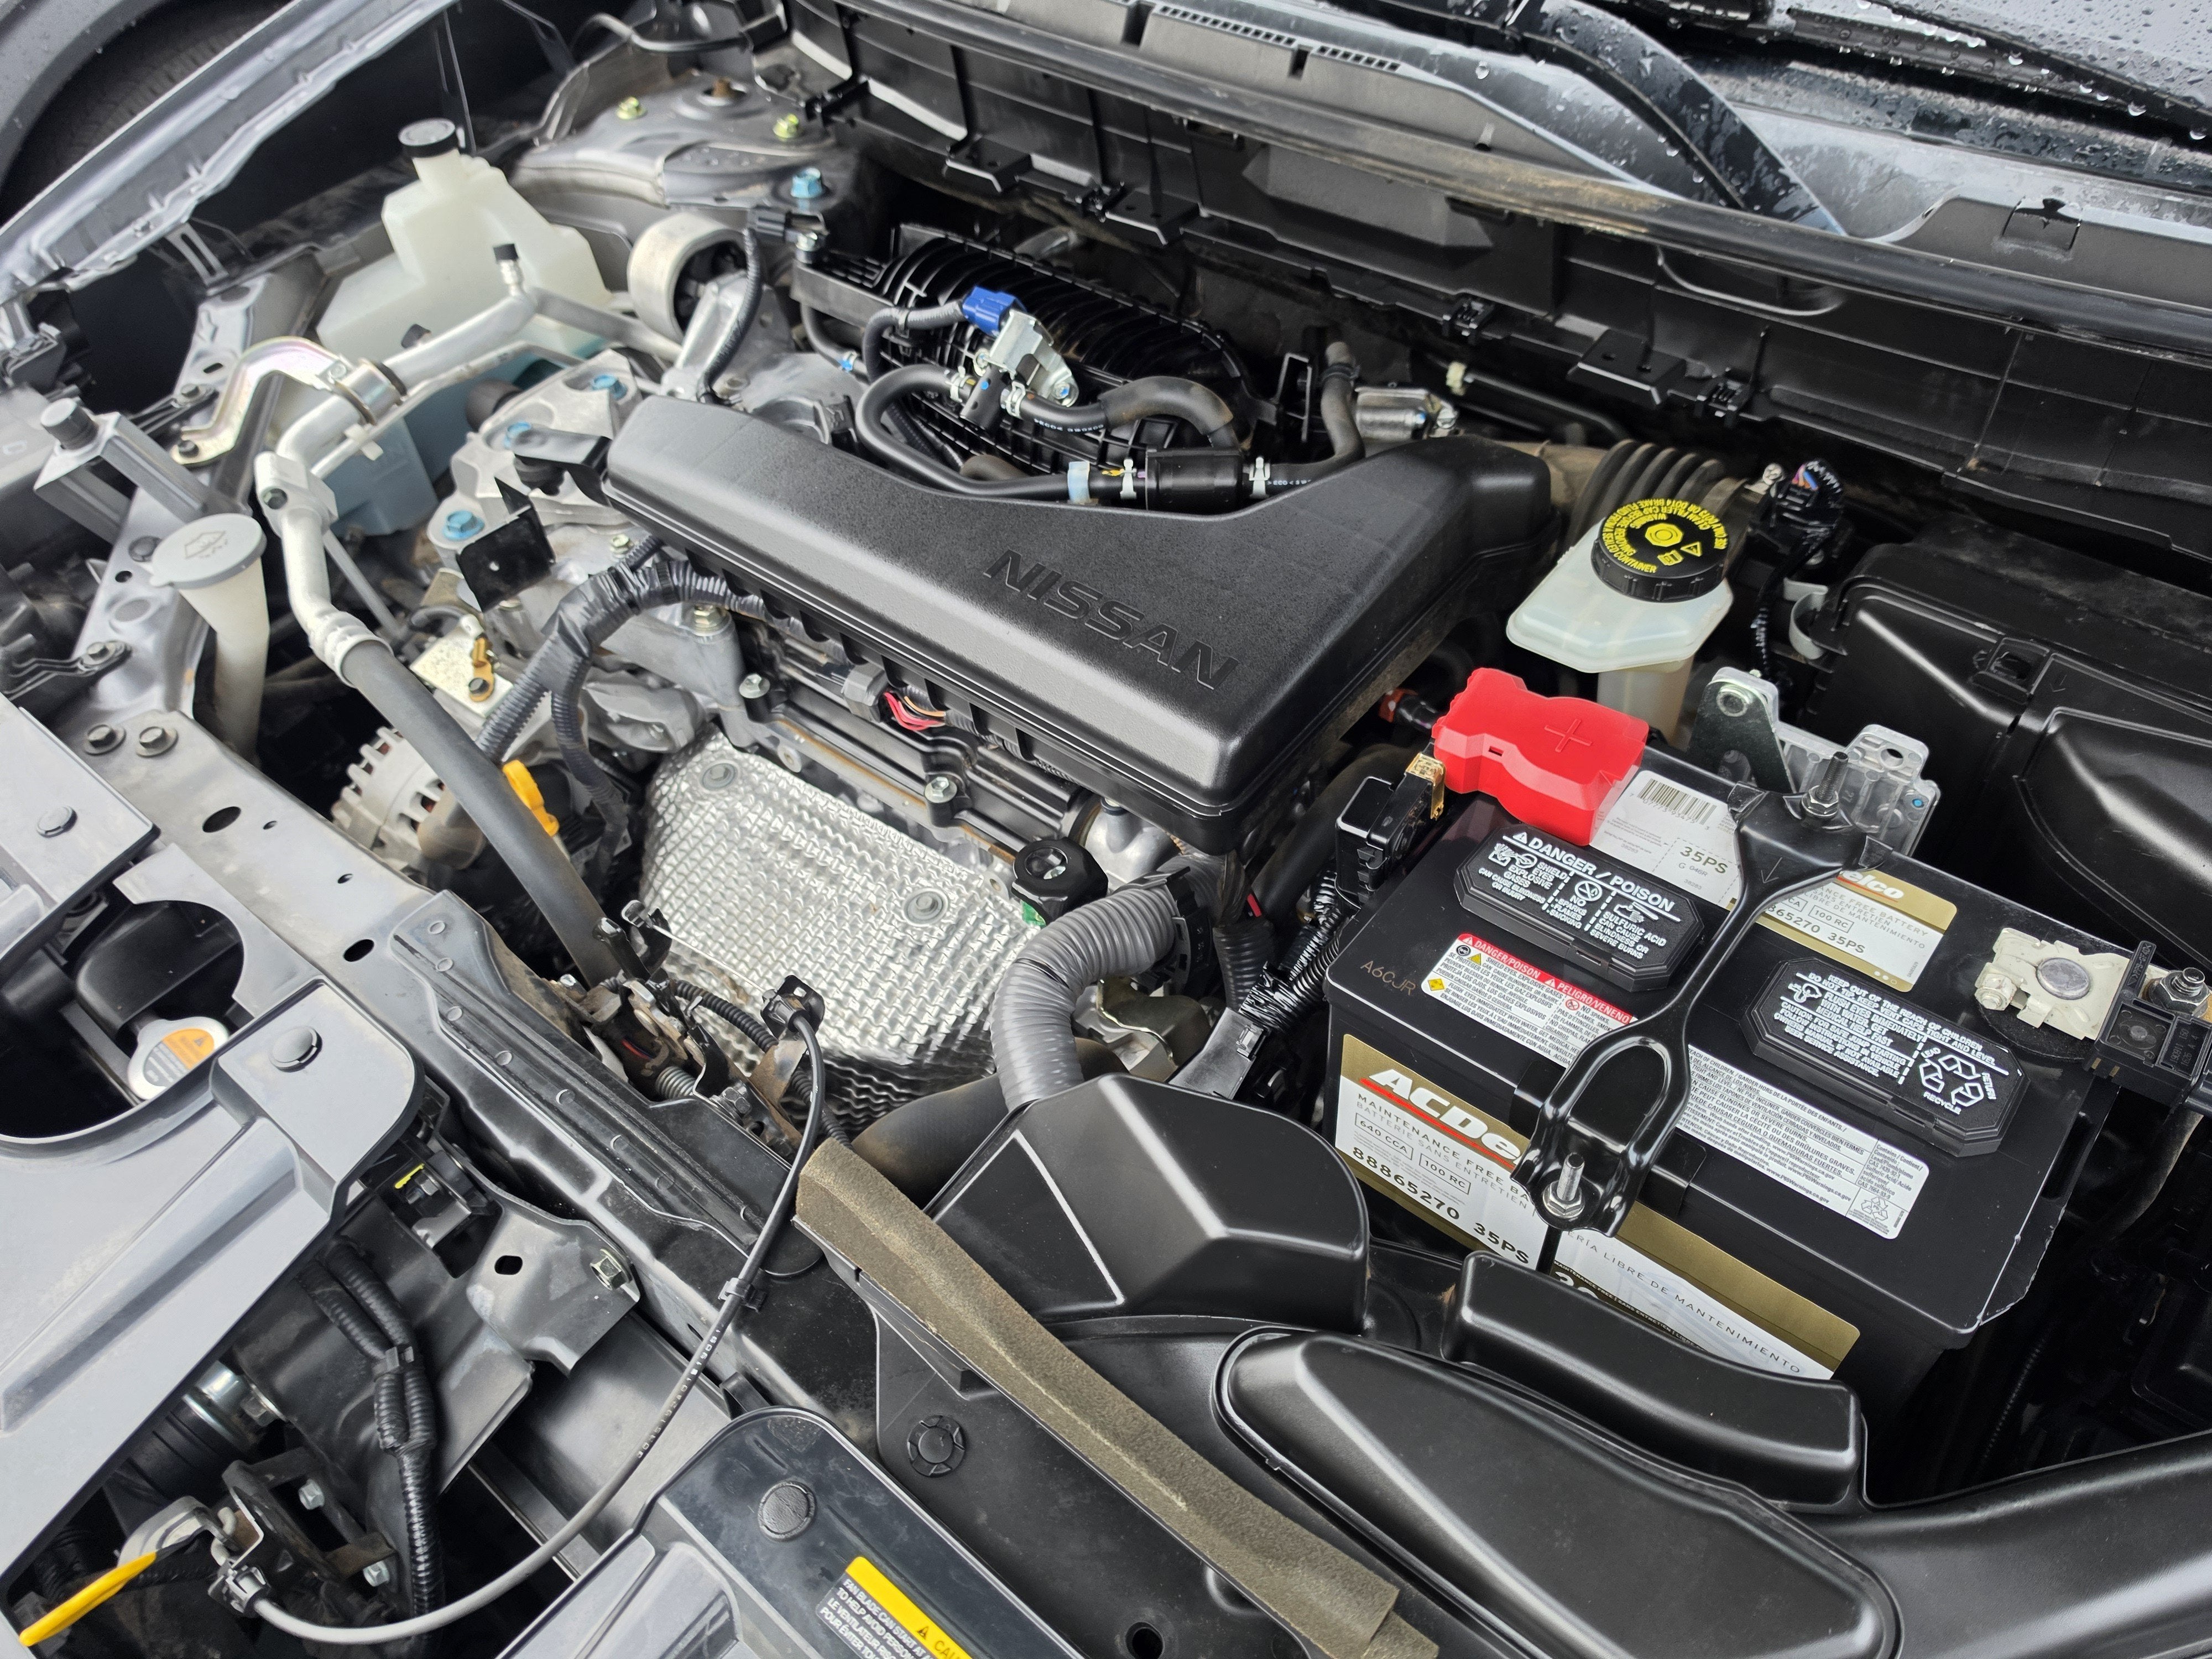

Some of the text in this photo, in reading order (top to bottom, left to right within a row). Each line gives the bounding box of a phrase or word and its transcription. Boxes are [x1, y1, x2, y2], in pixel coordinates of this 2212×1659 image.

[1614, 551, 1657, 573] CONTAINER
[983, 549, 1239, 690] NISSAN
[1508, 865, 1552, 889] EXPLOSIVE
[1528, 838, 1596, 874] DANGER
[1610, 875, 1674, 911] POISON
[1532, 868, 1554, 881] EYES
[1537, 862, 1567, 879] SHIELD
[1680, 846, 1728, 873] 35PS
[1689, 865, 1708, 876] 046R
[1478, 868, 1545, 903] CAN CAUSE BLINDNESS
[1491, 881, 1525, 900] OR INJURY
[1504, 871, 1530, 887] GASES
[1842, 870, 1906, 900] elco
[1553, 904, 1582, 920] FLAMES
[1558, 898, 1587, 915] SPARKS
[1569, 895, 1586, 906] NO
[1813, 888, 1835, 902] SANS
[1839, 900, 1890, 925] ENTRETIEN
[1849, 899, 1928, 936] FREE BATTERY
[1549, 909, 1582, 928] SMOKING
[1599, 918, 1641, 942] CAN CAUSE
[1603, 911, 1666, 946] SULFURIC ACID
[1767, 904, 1865, 953] 865270 35PS
[1815, 910, 1832, 920] 100
[1834, 919, 1848, 927] RC
[1833, 904, 1845, 912] DE
[1848, 911, 1924, 948] MANTENIMIENTO
[1590, 929, 1643, 958] SEVERE BURNS
[1594, 924, 1648, 953] BLINDNESS OR
[1473, 941, 1540, 978] DANGER/POISON
[1360, 961, 1416, 995] A6CJR
[1486, 957, 1504, 969] SHIELD
[1517, 974, 1545, 990] EXPLOSIVE
[1545, 988, 1563, 999] GASES
[1493, 968, 1508, 979] CAUSE
[1507, 976, 1533, 991] BLINDNESS
[1557, 983, 1629, 1022] PELIGRO/VENENO
[1580, 1005, 1590, 1013] NO
[1808, 973, 1821, 982] DO
[1822, 979, 1840, 990] NOT
[1857, 996, 1879, 1008] KEEP
[1880, 1006, 1902, 1020] VENT
[1902, 1018, 1924, 1030] CAPS
[1926, 1027, 1951, 1042] TIGHT
[1951, 1041, 1969, 1052] AND
[1820, 999, 1841, 1013] WITH
[1871, 1023, 1888, 1035] GET
[1824, 992, 1922, 1041] FLUSH EYES IMMEDIATELY
[1828, 974, 1849, 987] KEEP
[1850, 985, 1868, 997] OUT
[1882, 1000, 1899, 1012] THE
[1899, 1009, 1927, 1025] REACH
[1928, 1022, 1941, 1030] OF
[1942, 1029, 1982, 1051] CHILDREN
[1780, 1008, 1809, 1025] FOLLOW
[1809, 1022, 1860, 1051] INSTRUCTIONS
[1870, 1052, 1900, 1070] VEHICLE
[1781, 1001, 1906, 1065] CAUTION: FOR SAFE JUMP STARTING
[1815, 1006, 1893, 1046] MEDICAL HELP FAST
[1804, 1035, 1834, 1053] SERVICE
[1921, 1047, 1940, 1058] LEAD
[1844, 1047, 1861, 1059] NOT
[1861, 1056, 1899, 1077] AVAILABLE
[1923, 1091, 1961, 1114] RECYCLE
[1981, 1072, 1996, 1100] RETURN
[1370, 1070, 1520, 1163] ACDe
[1698, 1083, 1718, 1095] CAUSE
[1719, 1093, 1750, 1112] BLINDNES
[1760, 1114, 1784, 1129] SEVERE
[1358, 1093, 1459, 1159] MAINTENANCE
[1467, 1159, 1503, 1185] FREE
[1360, 1120, 1407, 1153] 640 CCA
[1357, 1101, 1412, 1140] BATTERIE
[1418, 1139, 1449, 1162] SANS
[1455, 1162, 1526, 1208] ENTRETIEN
[1426, 1160, 1465, 1187] 100 RC
[1353, 1147, 1459, 1219] 88865270
[1474, 1223, 1528, 1263] 35PS
[1604, 1253, 1644, 1280] LIBRE
[1650, 1280, 1668, 1294] DE
[1675, 1295, 1799, 1373] MANTENIMIENTO
[820, 1607, 864, 1651] POUR ÉVITER
[827, 1598, 880, 1650] LE VENTILATEUR
[837, 1587, 849, 1600] TO
[845, 1597, 866, 1615] HELP
[862, 1614, 886, 1636] AVOID
[843, 1579, 857, 1595] FAN
[857, 1592, 881, 1616] BLADE
[878, 1613, 896, 1629] CAN
[893, 1626, 917, 1648] START
